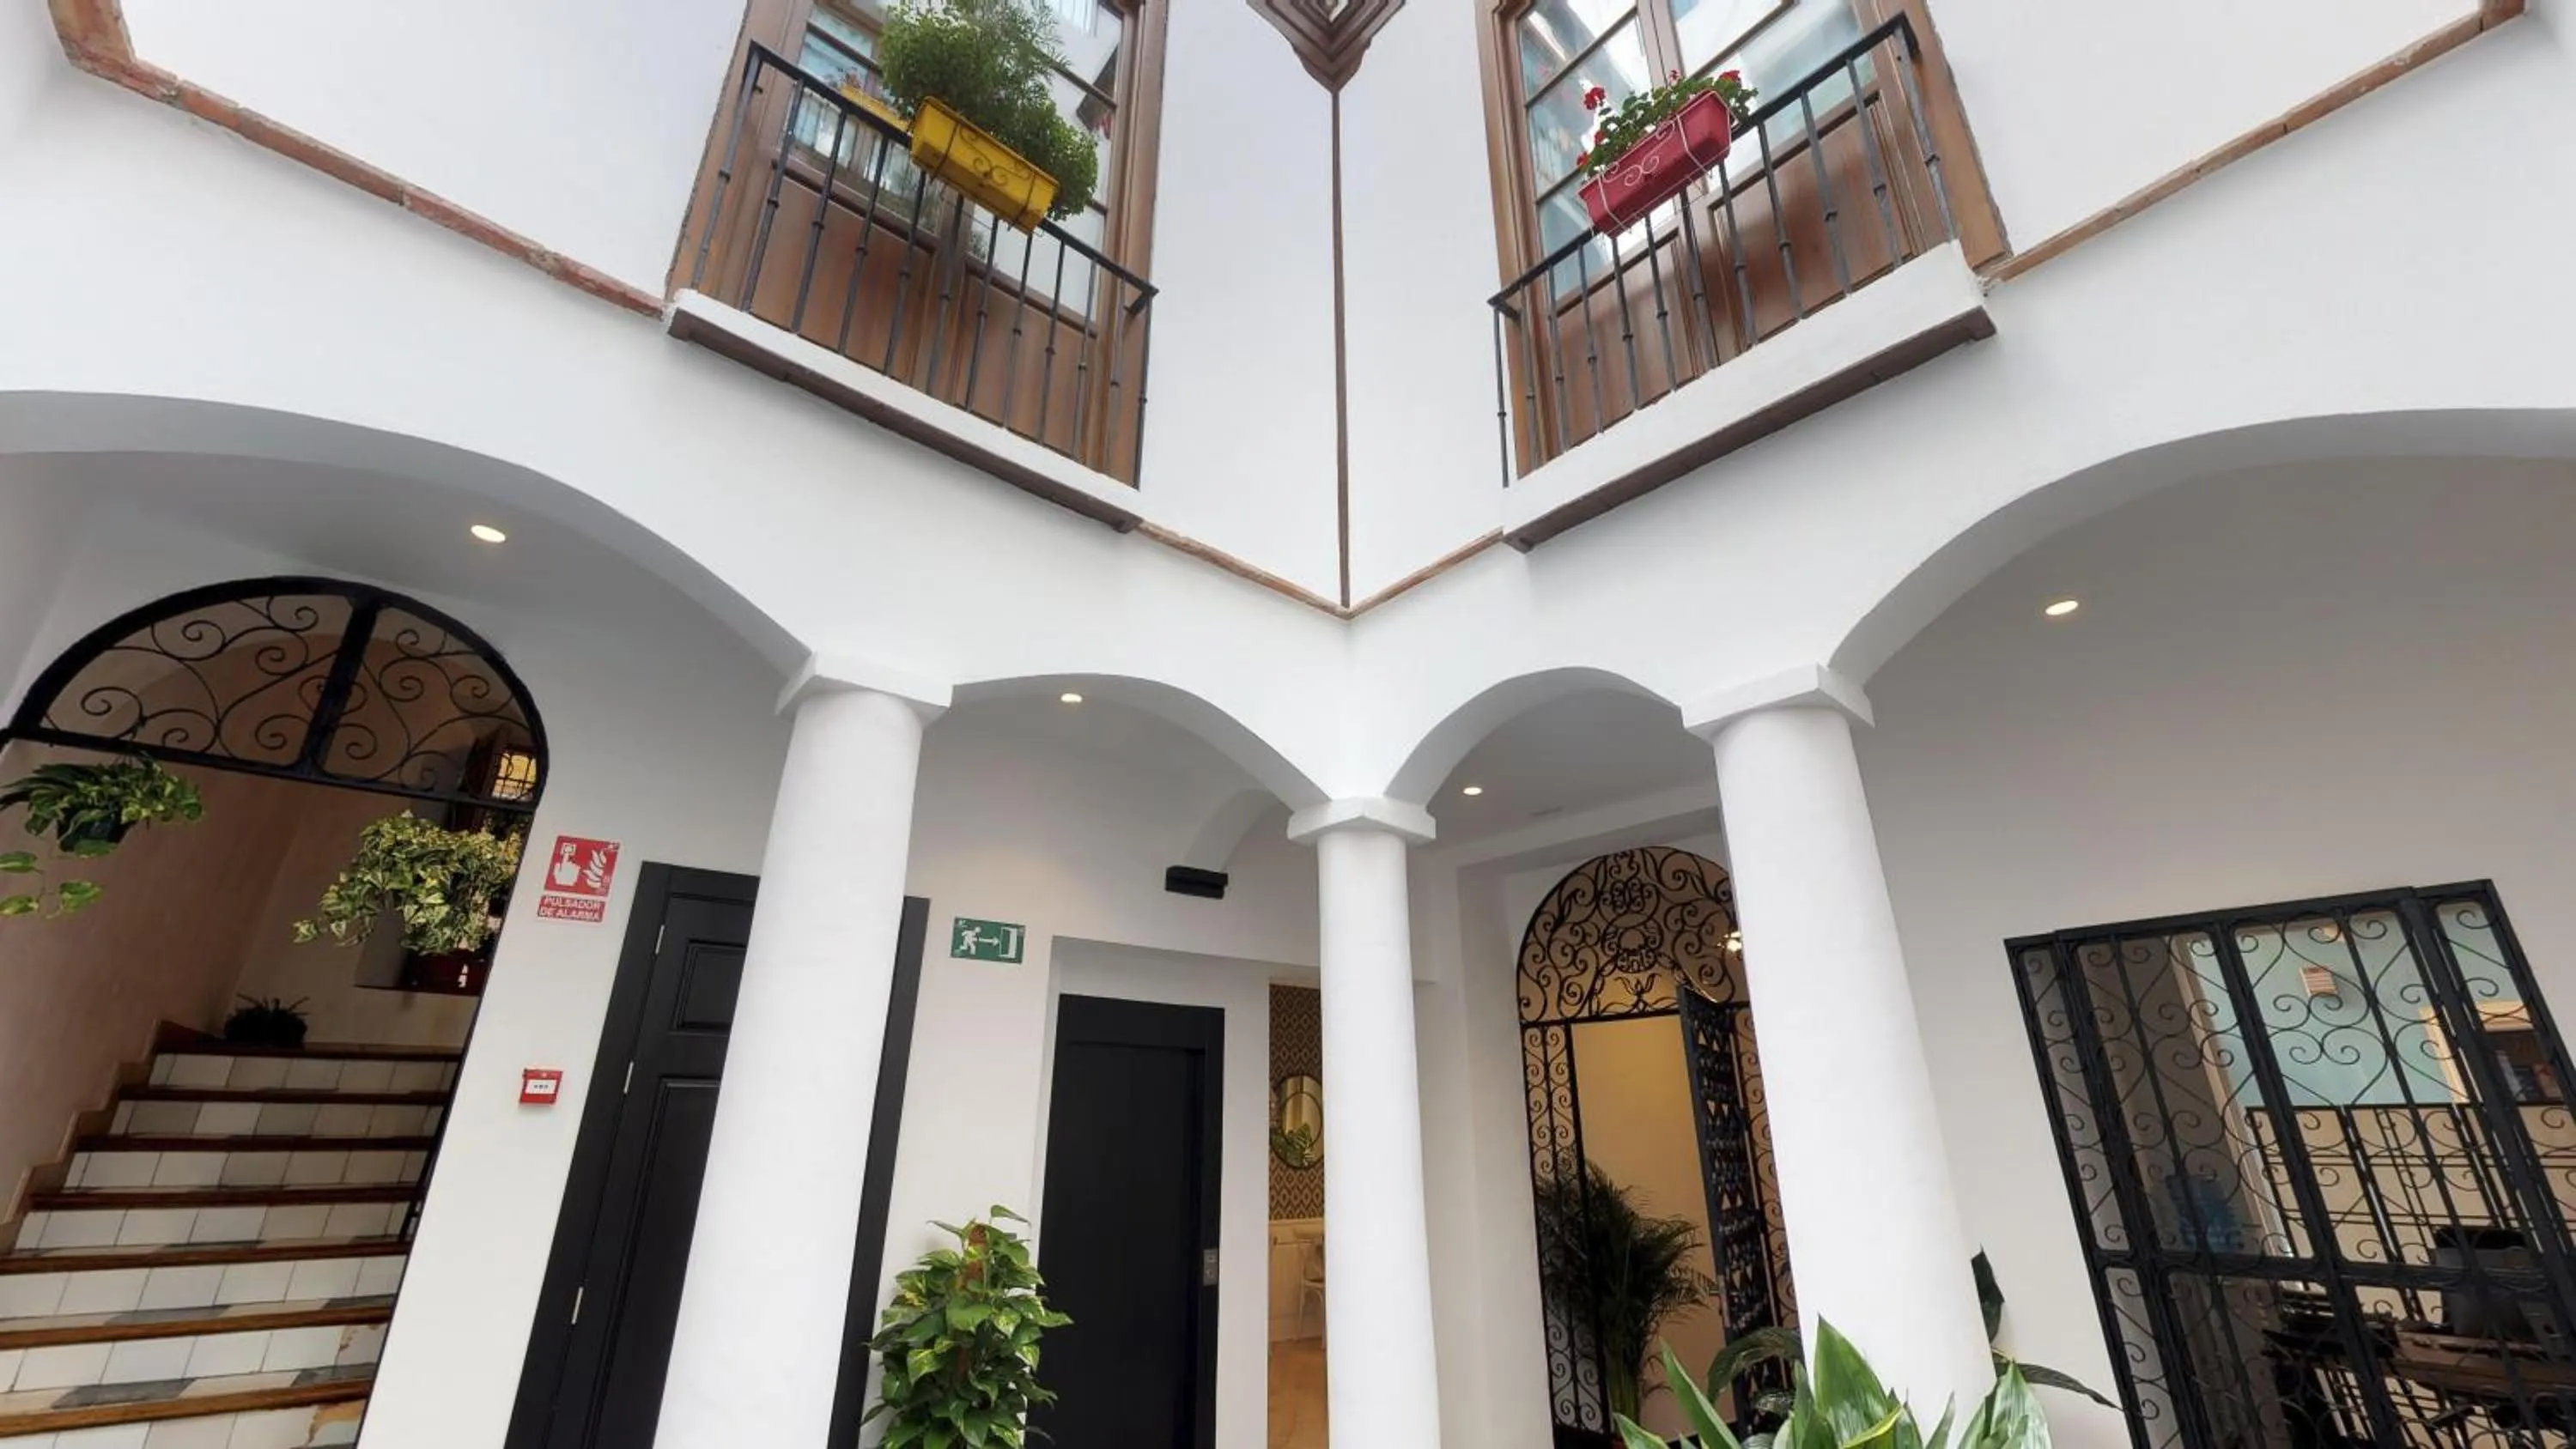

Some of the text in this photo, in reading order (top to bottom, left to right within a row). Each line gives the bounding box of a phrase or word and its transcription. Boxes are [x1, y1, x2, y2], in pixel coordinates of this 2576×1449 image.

[543, 897, 601, 910] PULSADOR
[539, 906, 599, 920] DE ALARMA
